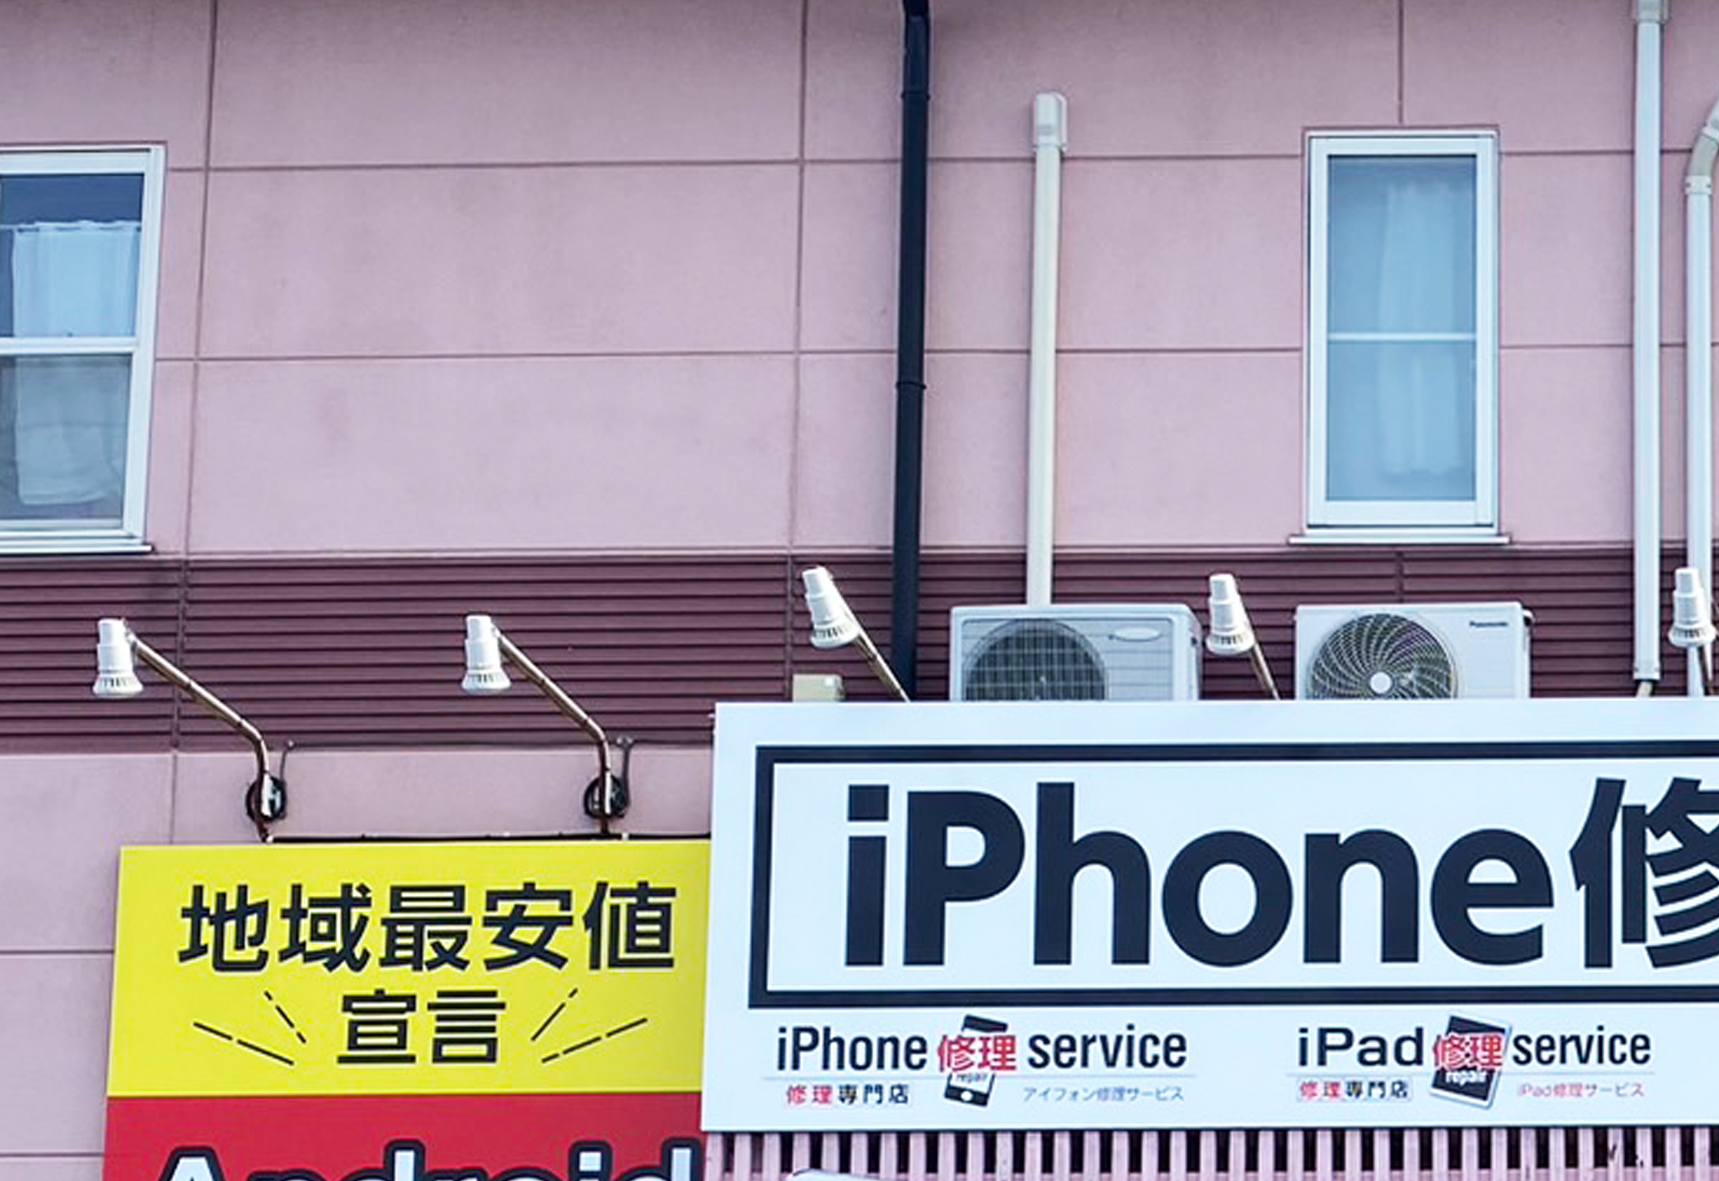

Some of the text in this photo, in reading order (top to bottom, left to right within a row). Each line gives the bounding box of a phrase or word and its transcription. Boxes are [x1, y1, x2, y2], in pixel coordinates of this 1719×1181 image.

[178, 881, 677, 973] 地域最安値
[337, 988, 507, 1065] 宣言
[777, 1024, 1188, 1072] iPhone 修理 service
[1298, 1025, 1651, 1069] iPad 修理 service
[786, 1084, 909, 1105] 修理専門店
